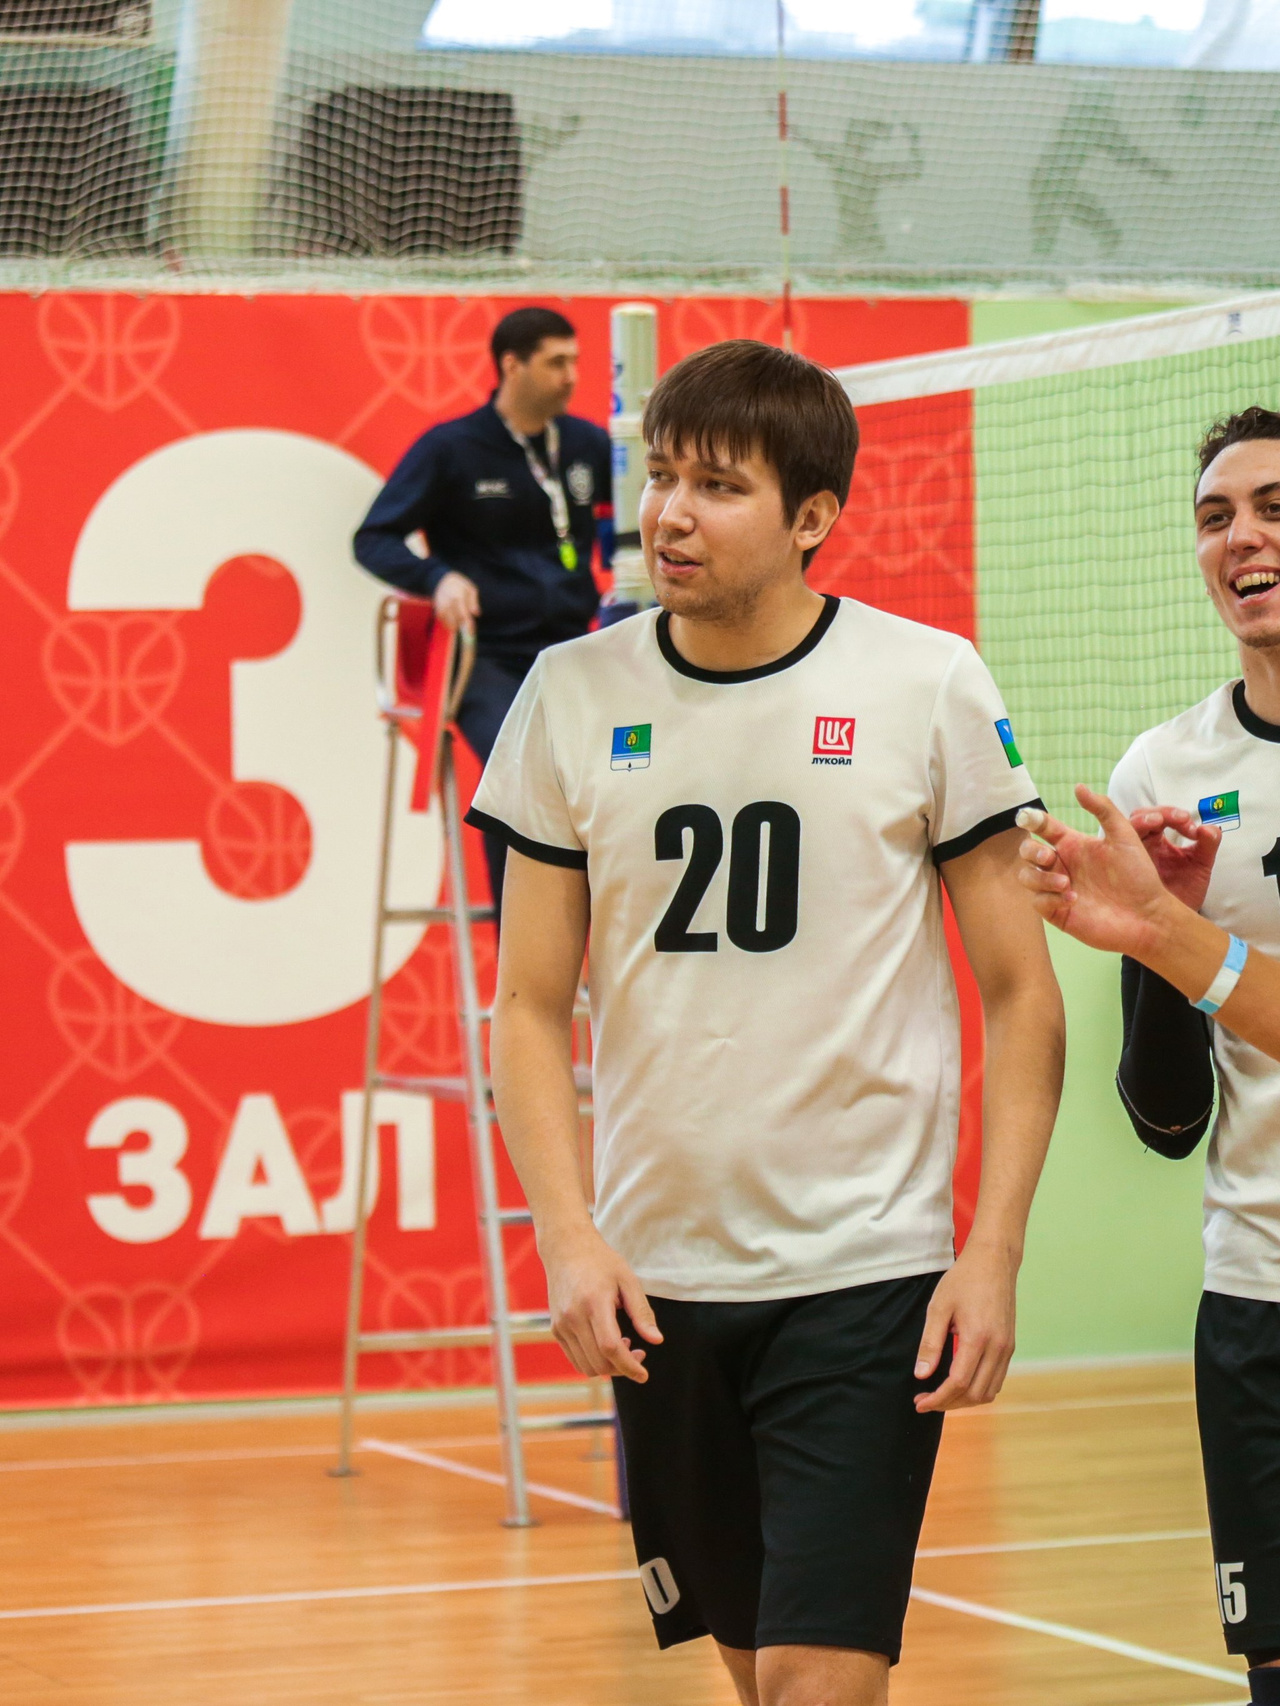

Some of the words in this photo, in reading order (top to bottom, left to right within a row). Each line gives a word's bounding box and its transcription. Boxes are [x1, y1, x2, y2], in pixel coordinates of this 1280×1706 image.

[67, 428, 442, 1026] 3
[811, 756, 852, 766] ЛУКОЙЛ
[654, 801, 800, 952] 20
[85, 1089, 436, 1244] ЗАЛ
